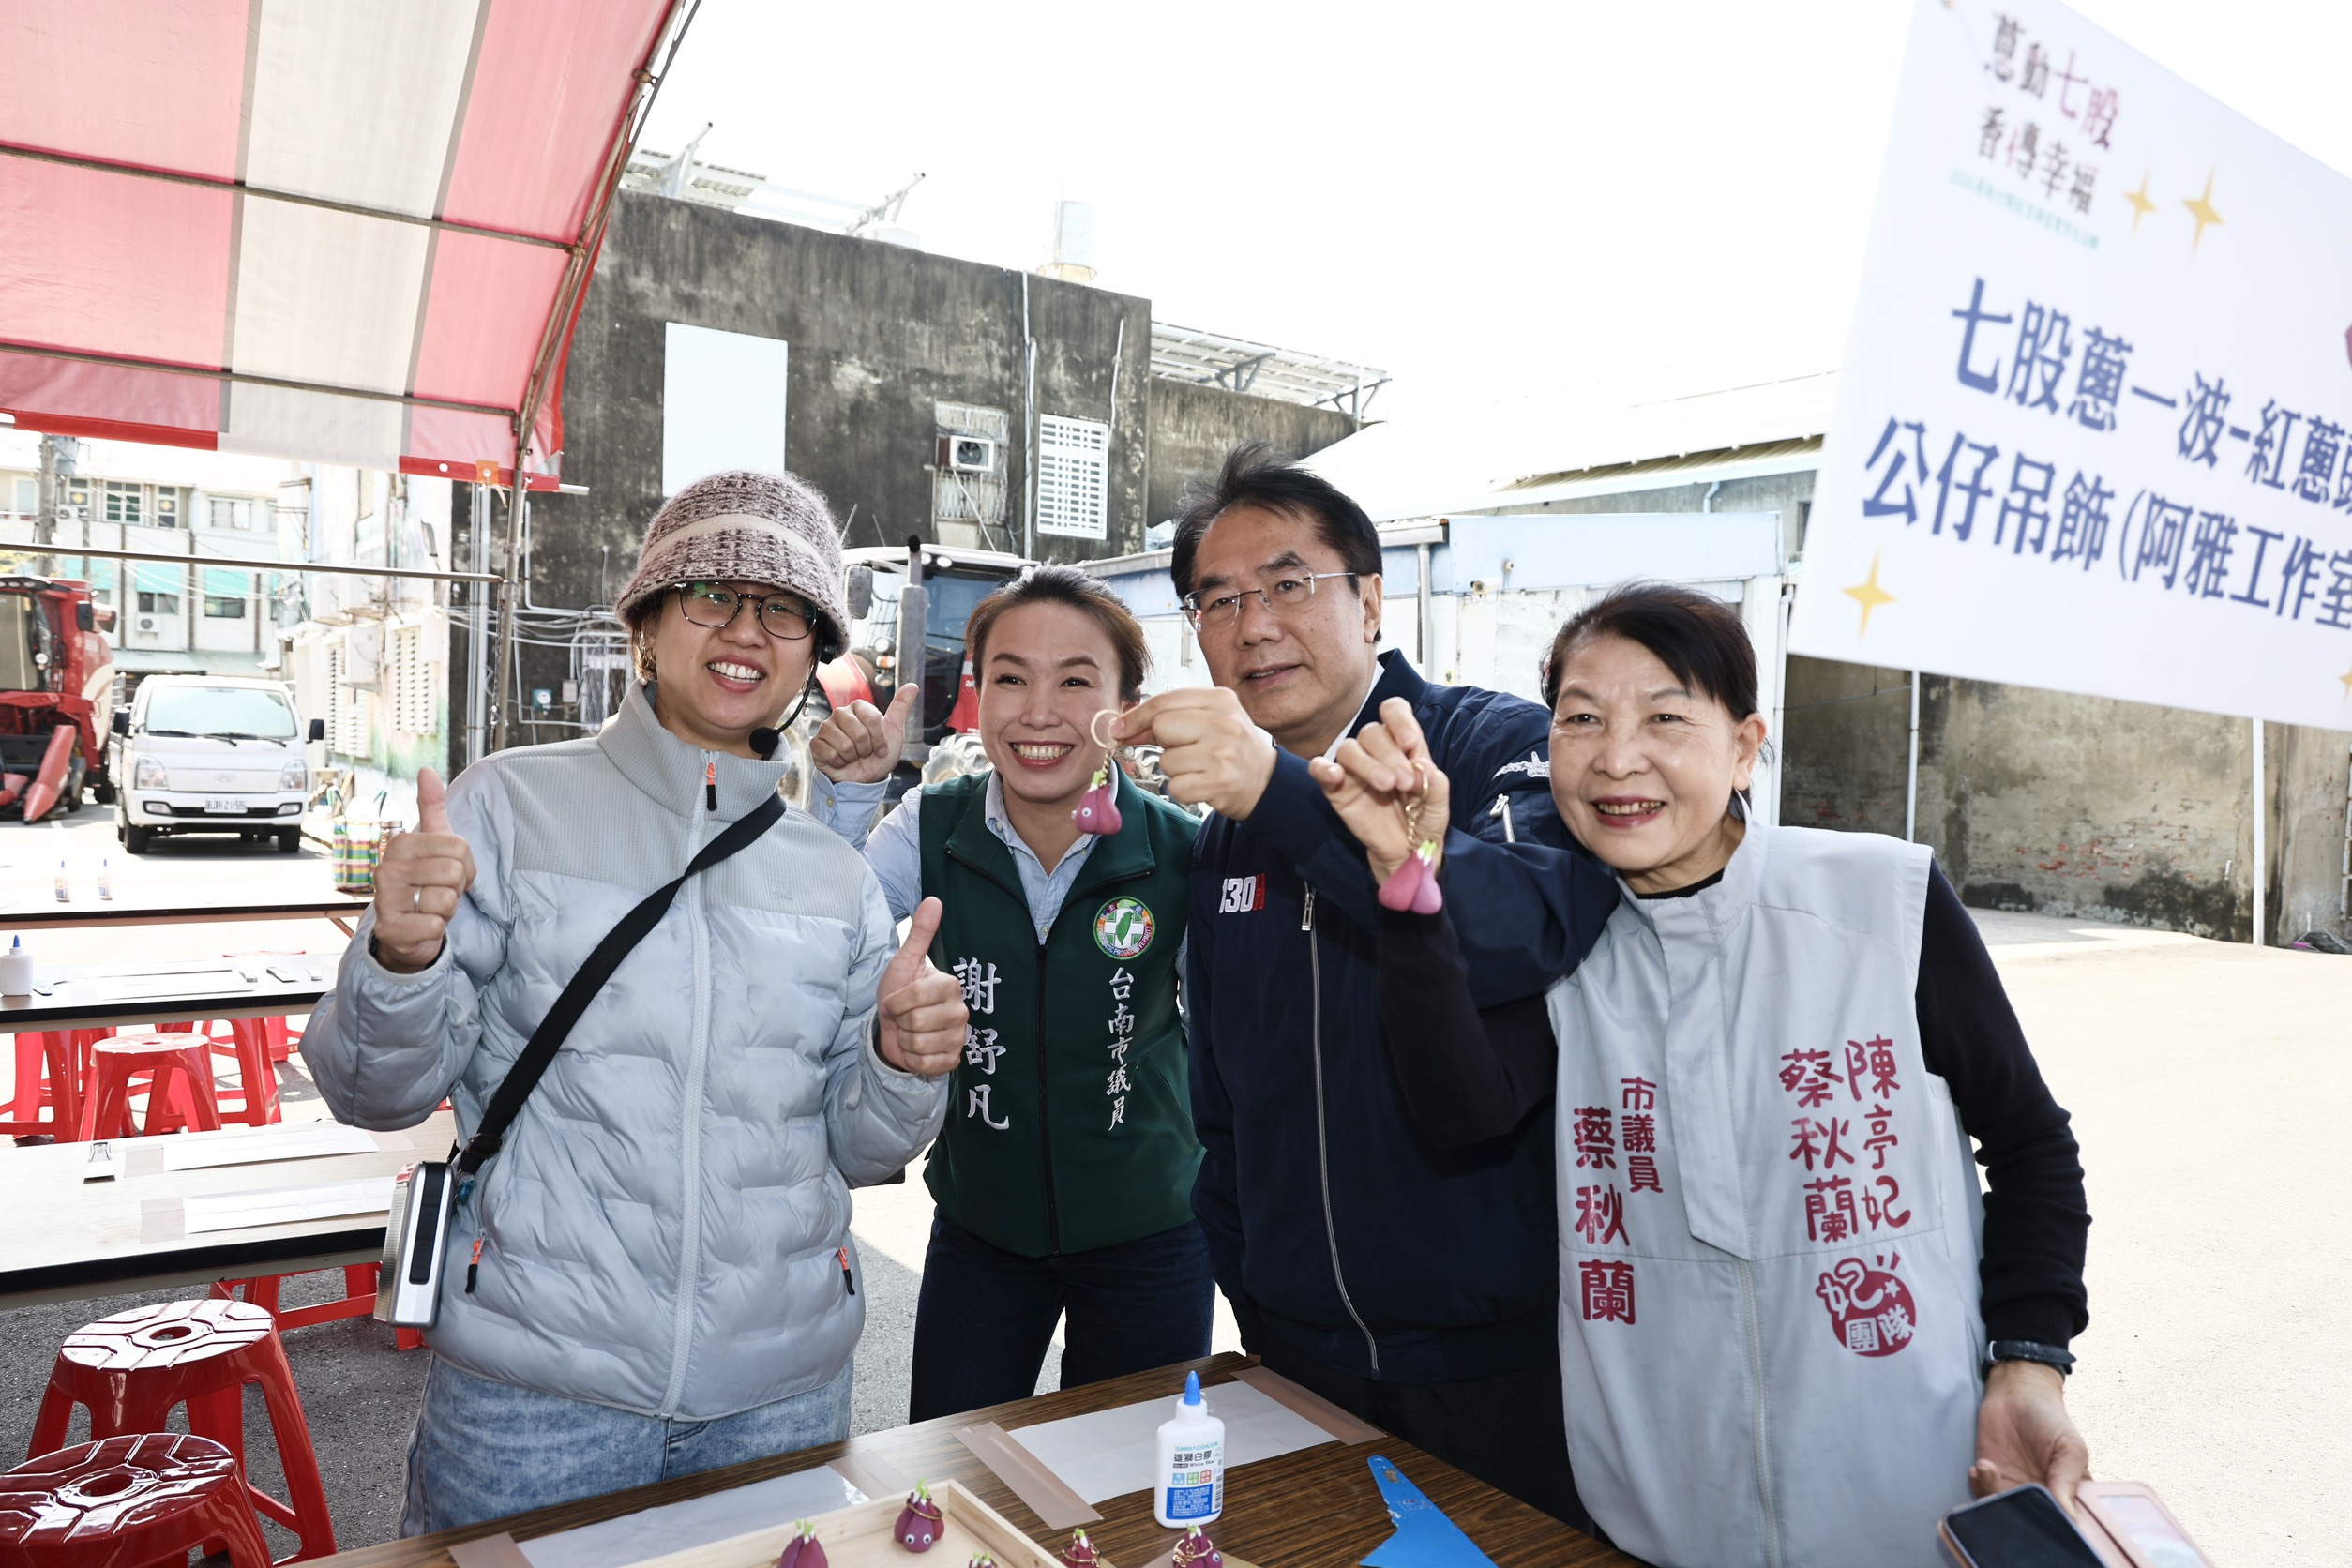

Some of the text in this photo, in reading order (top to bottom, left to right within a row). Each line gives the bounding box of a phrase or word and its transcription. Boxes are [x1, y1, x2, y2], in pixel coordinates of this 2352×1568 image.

[1977, 105, 2101, 215] 香傳幸福
[952, 957, 1010, 1131] 謝舒凡
[1107, 967, 1135, 1132] 台南市議員
[1573, 1106, 1636, 1325] 蔡秋蘭
[1621, 1076, 1664, 1194] 市議員
[1779, 1048, 1859, 1244] 蔡秋蘭
[1845, 1033, 1912, 1232] 陳亭妃
[1844, 1304, 1915, 1353] 團隊
